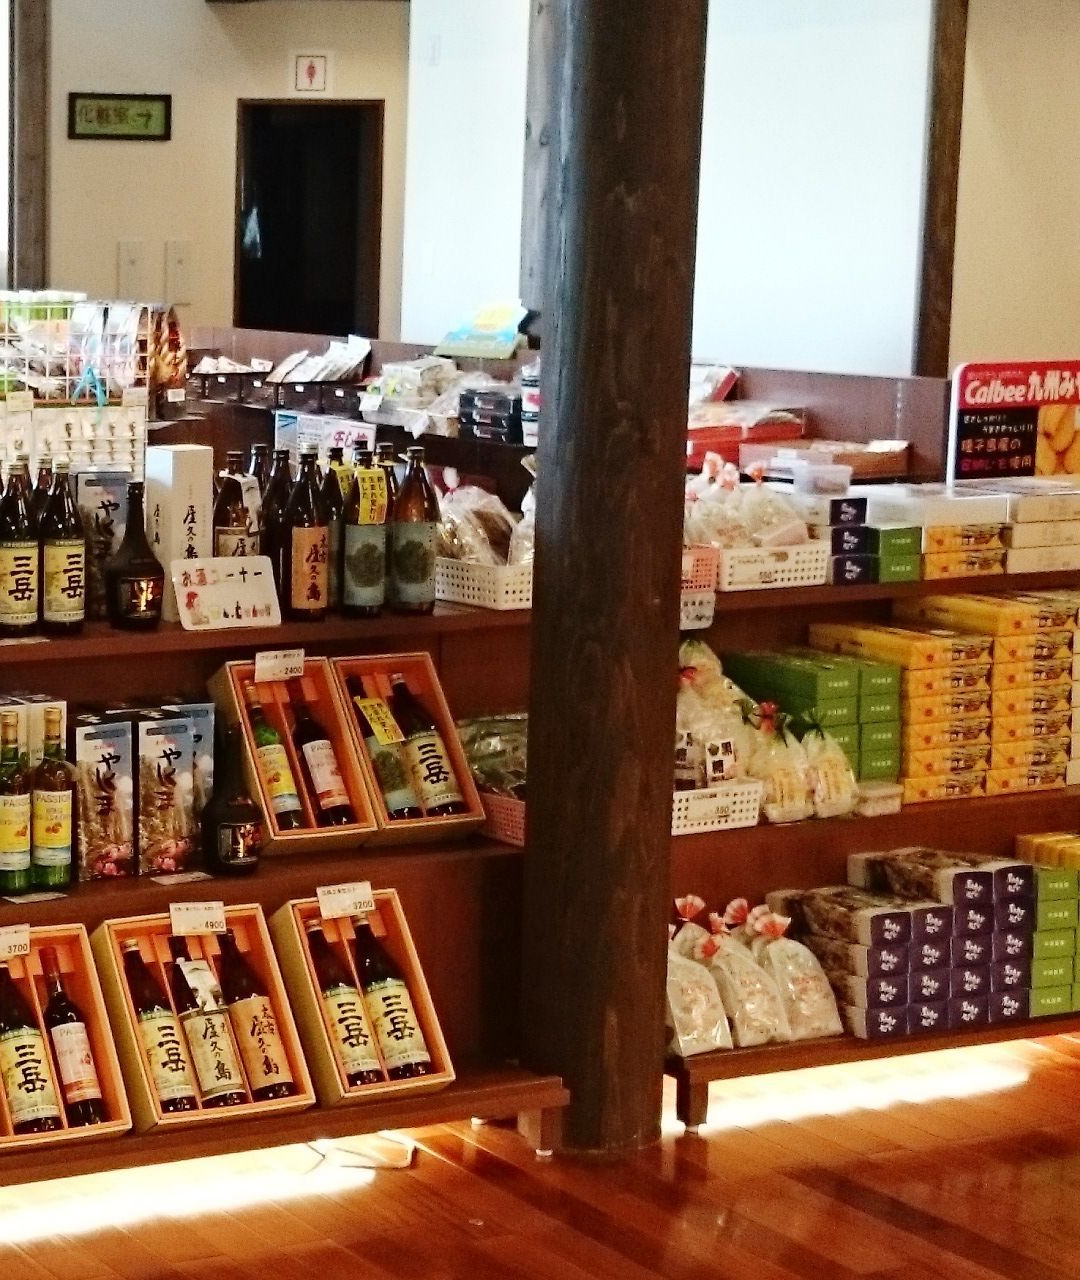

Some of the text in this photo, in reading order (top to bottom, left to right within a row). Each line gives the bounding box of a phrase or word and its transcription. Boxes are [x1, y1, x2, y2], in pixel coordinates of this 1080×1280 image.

[965, 380, 1026, 404] Calbee
[8, 556, 35, 601] 三岳
[61, 553, 84, 600] 三岳
[417, 742, 450, 786] 三岳
[204, 920, 225, 929] 4900
[7, 943, 28, 954] 3700
[337, 1001, 369, 1049] 三岳
[381, 994, 415, 1041] 三岳
[14, 1043, 48, 1094] 三岳
[156, 1024, 186, 1073] 三岳
[202, 1017, 232, 1081] 屋久の島
